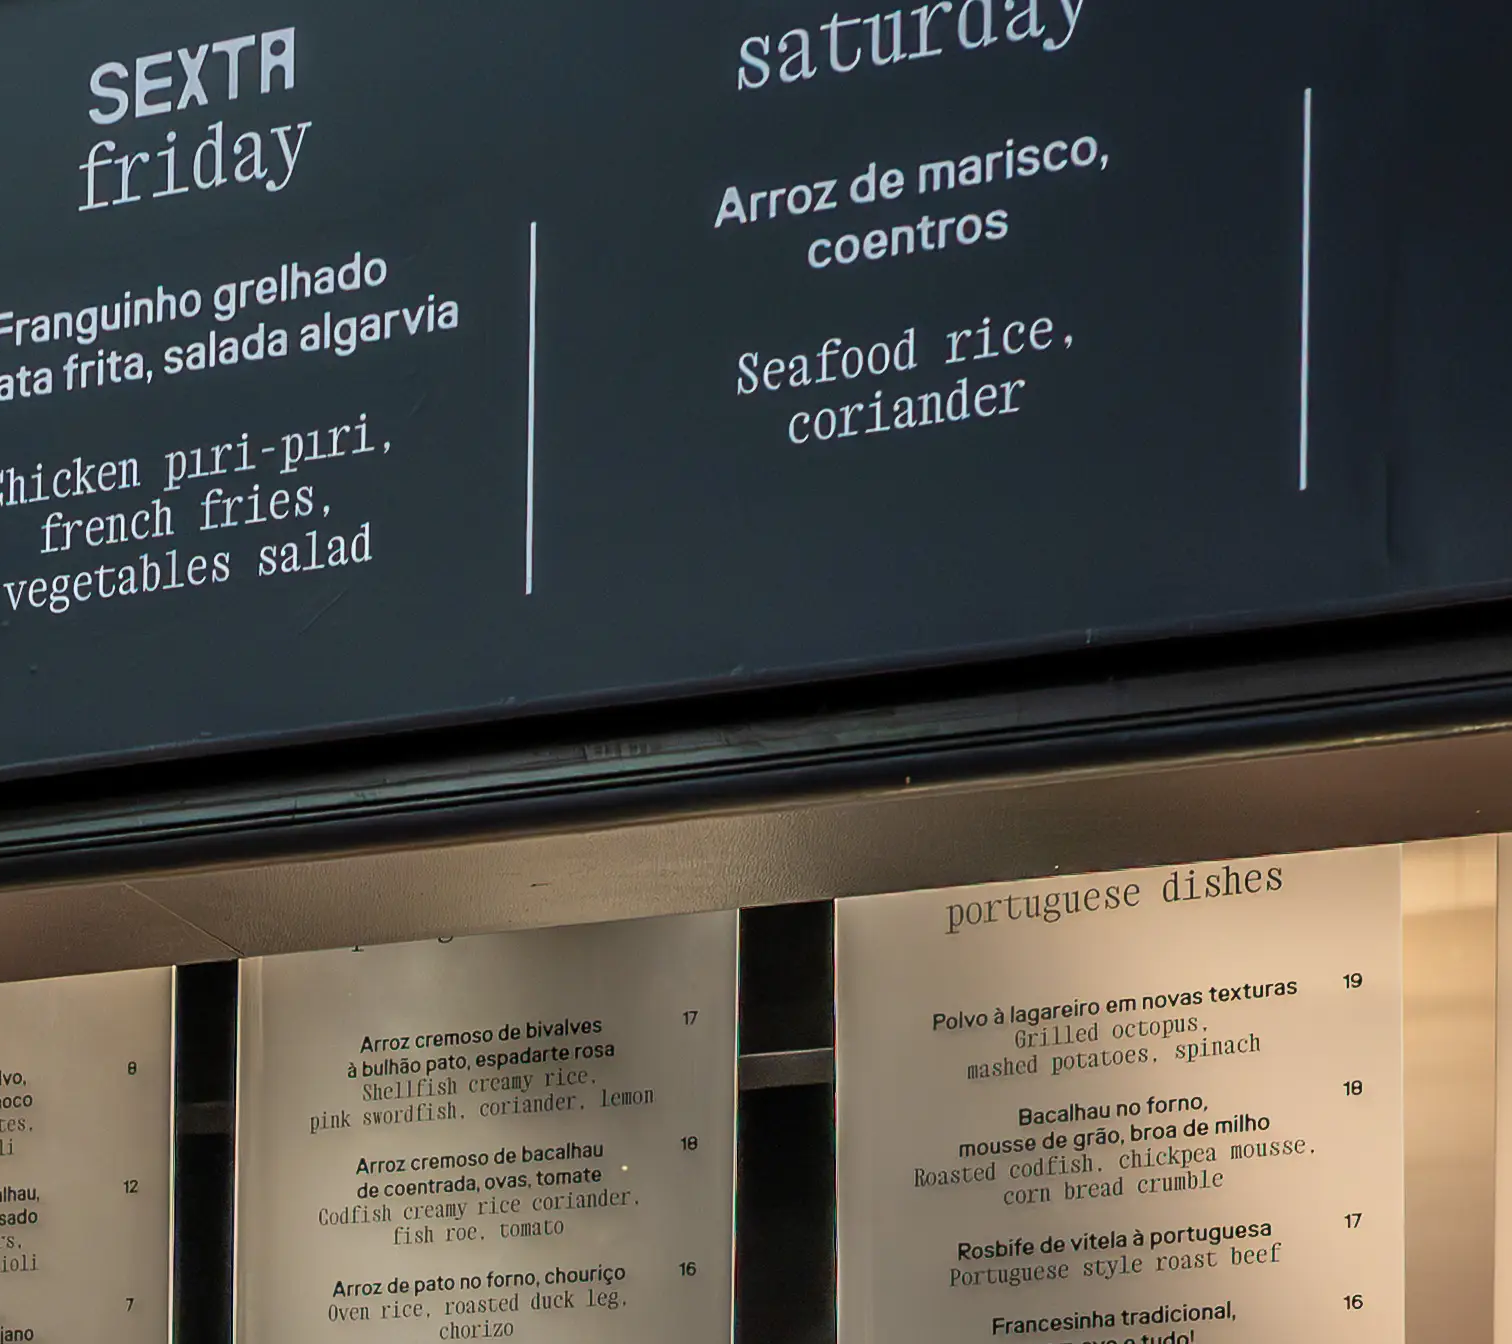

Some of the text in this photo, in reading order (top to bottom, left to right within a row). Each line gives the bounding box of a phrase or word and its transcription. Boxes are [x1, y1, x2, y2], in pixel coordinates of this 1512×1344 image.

[89, 27, 295, 124] SEXTA
[738, 0, 1083, 90] saturday
[78, 121, 312, 211] friday
[714, 136, 1108, 228] Arroz de marisco,
[808, 210, 1008, 268] coentros
[214, 251, 387, 321] grelhado
[63, 349, 152, 390] frita,
[164, 323, 287, 374] salada
[300, 294, 458, 356] algarvia
[945, 865, 1282, 935] portuguese dishes
[360, 1011, 698, 1053] Arroz cremoso de bivalves 17
[933, 973, 1362, 1031] Polvo à lagareiro em novas texturas 19
[128, 1061, 137, 1075] 8
[958, 1213, 1362, 1261] Rosbife de vitela à portuguesa 17
